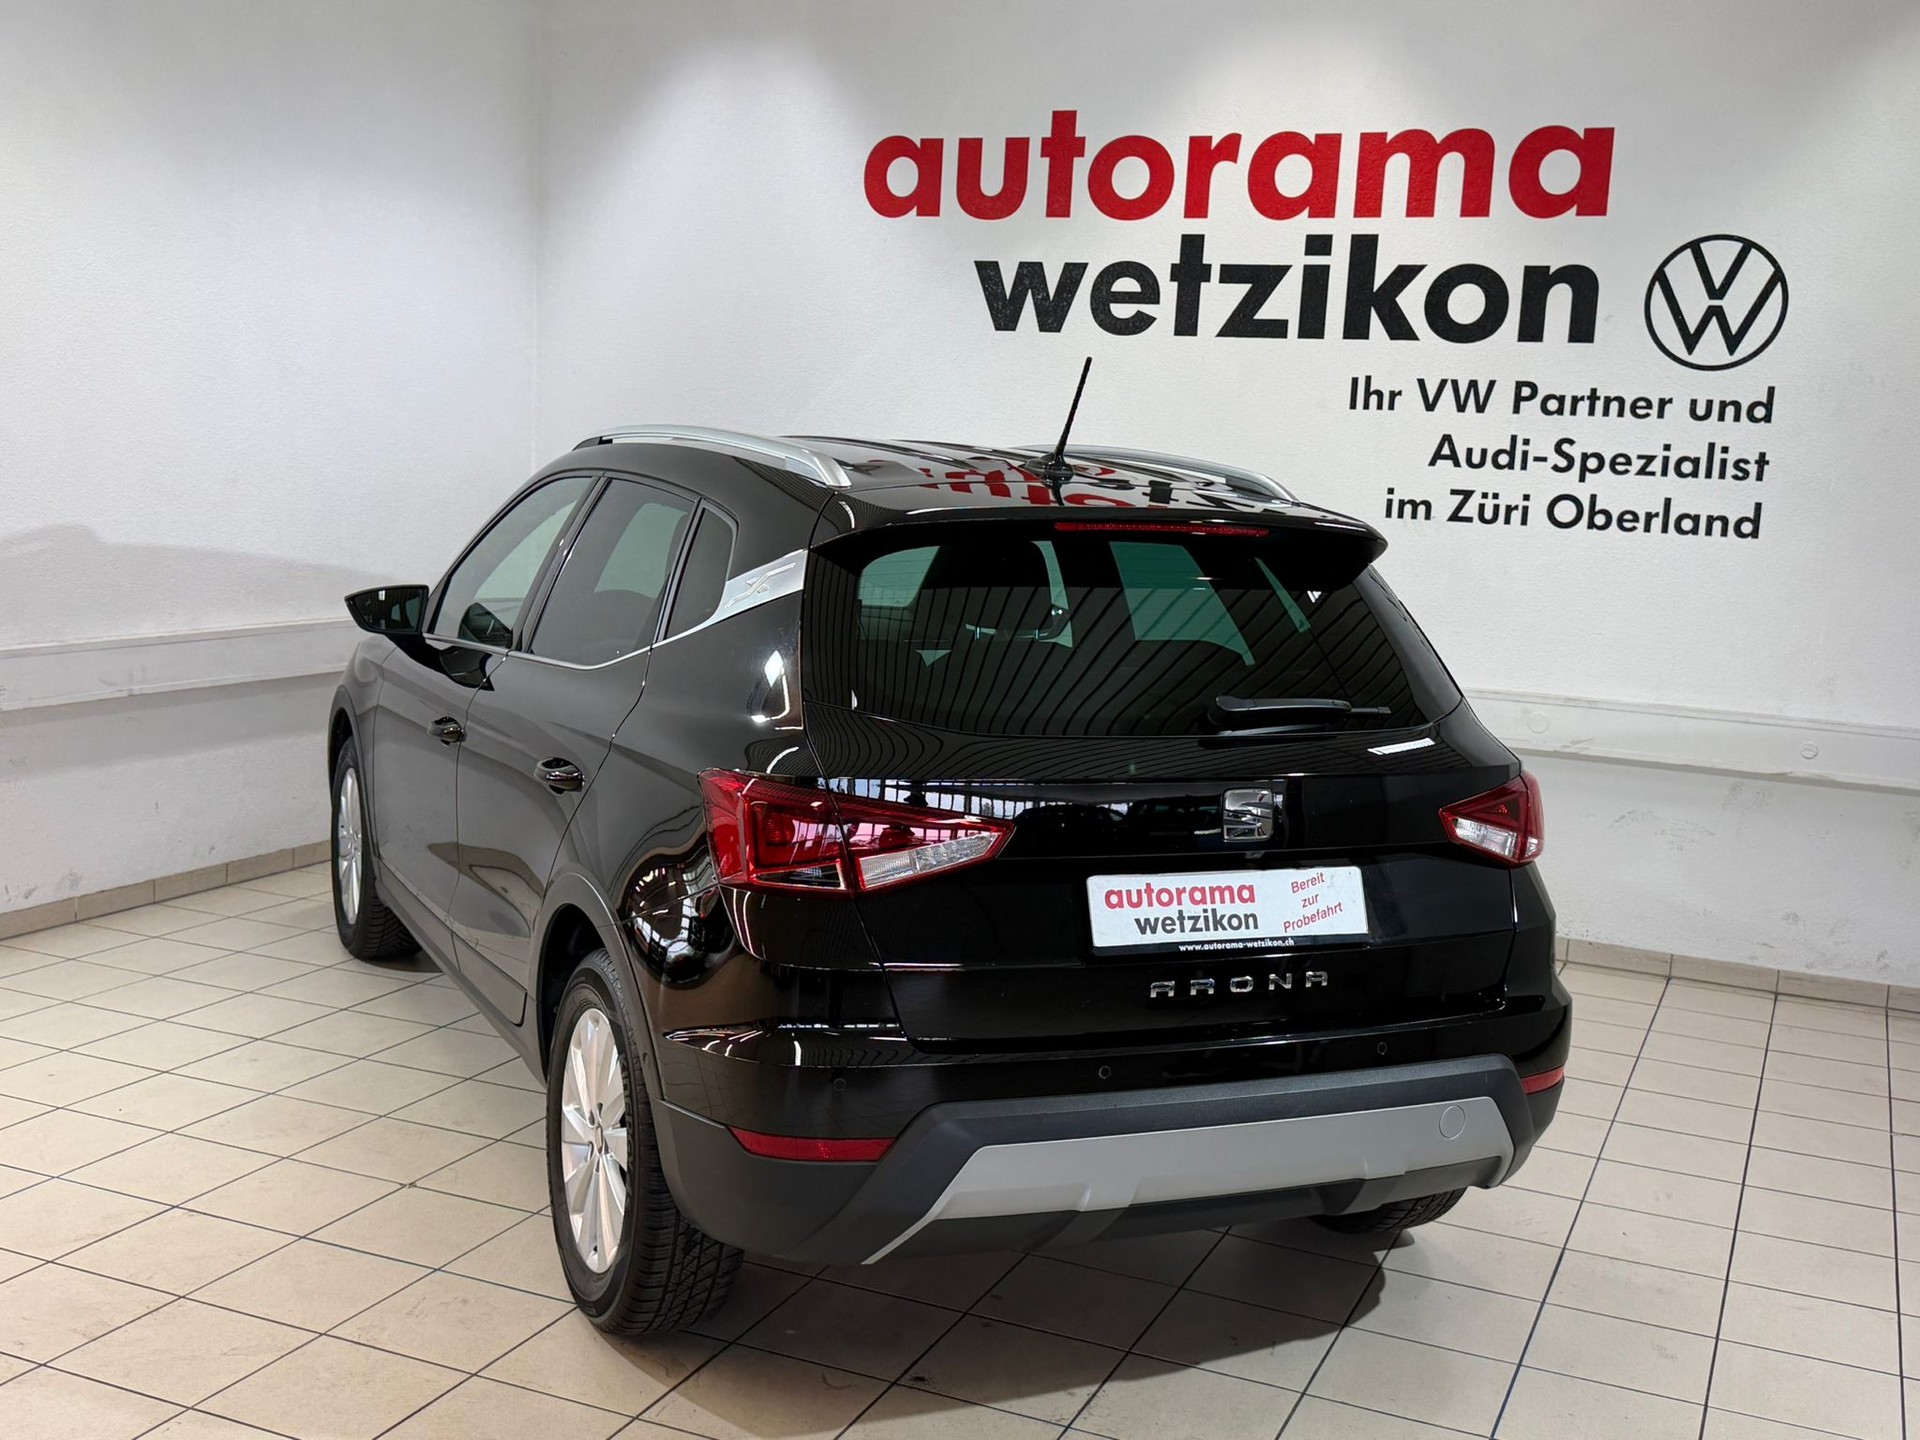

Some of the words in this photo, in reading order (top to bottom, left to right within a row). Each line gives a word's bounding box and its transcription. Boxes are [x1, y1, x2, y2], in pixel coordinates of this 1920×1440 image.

[865, 111, 1615, 221] autorama
[974, 234, 1600, 344] wetzikon
[1349, 376, 1403, 411] Ihr
[1417, 379, 1497, 413] VW
[1513, 381, 1674, 419] Partner
[1690, 386, 1776, 423] und
[1429, 434, 1770, 482] Audi-Spezialist
[1385, 487, 1432, 520] im
[1447, 489, 1531, 526] Züri
[1547, 494, 1763, 539] Oberland
[1104, 882, 1257, 909] autorama
[1290, 871, 1326, 894] Bereit
[1301, 893, 1319, 909] zur
[1134, 908, 1259, 935] wetzikon
[1283, 901, 1343, 934] Probefahrt
[1178, 937, 1295, 952] www.autorama-wetzikon.ch
[1150, 970, 1329, 999] ARONA
